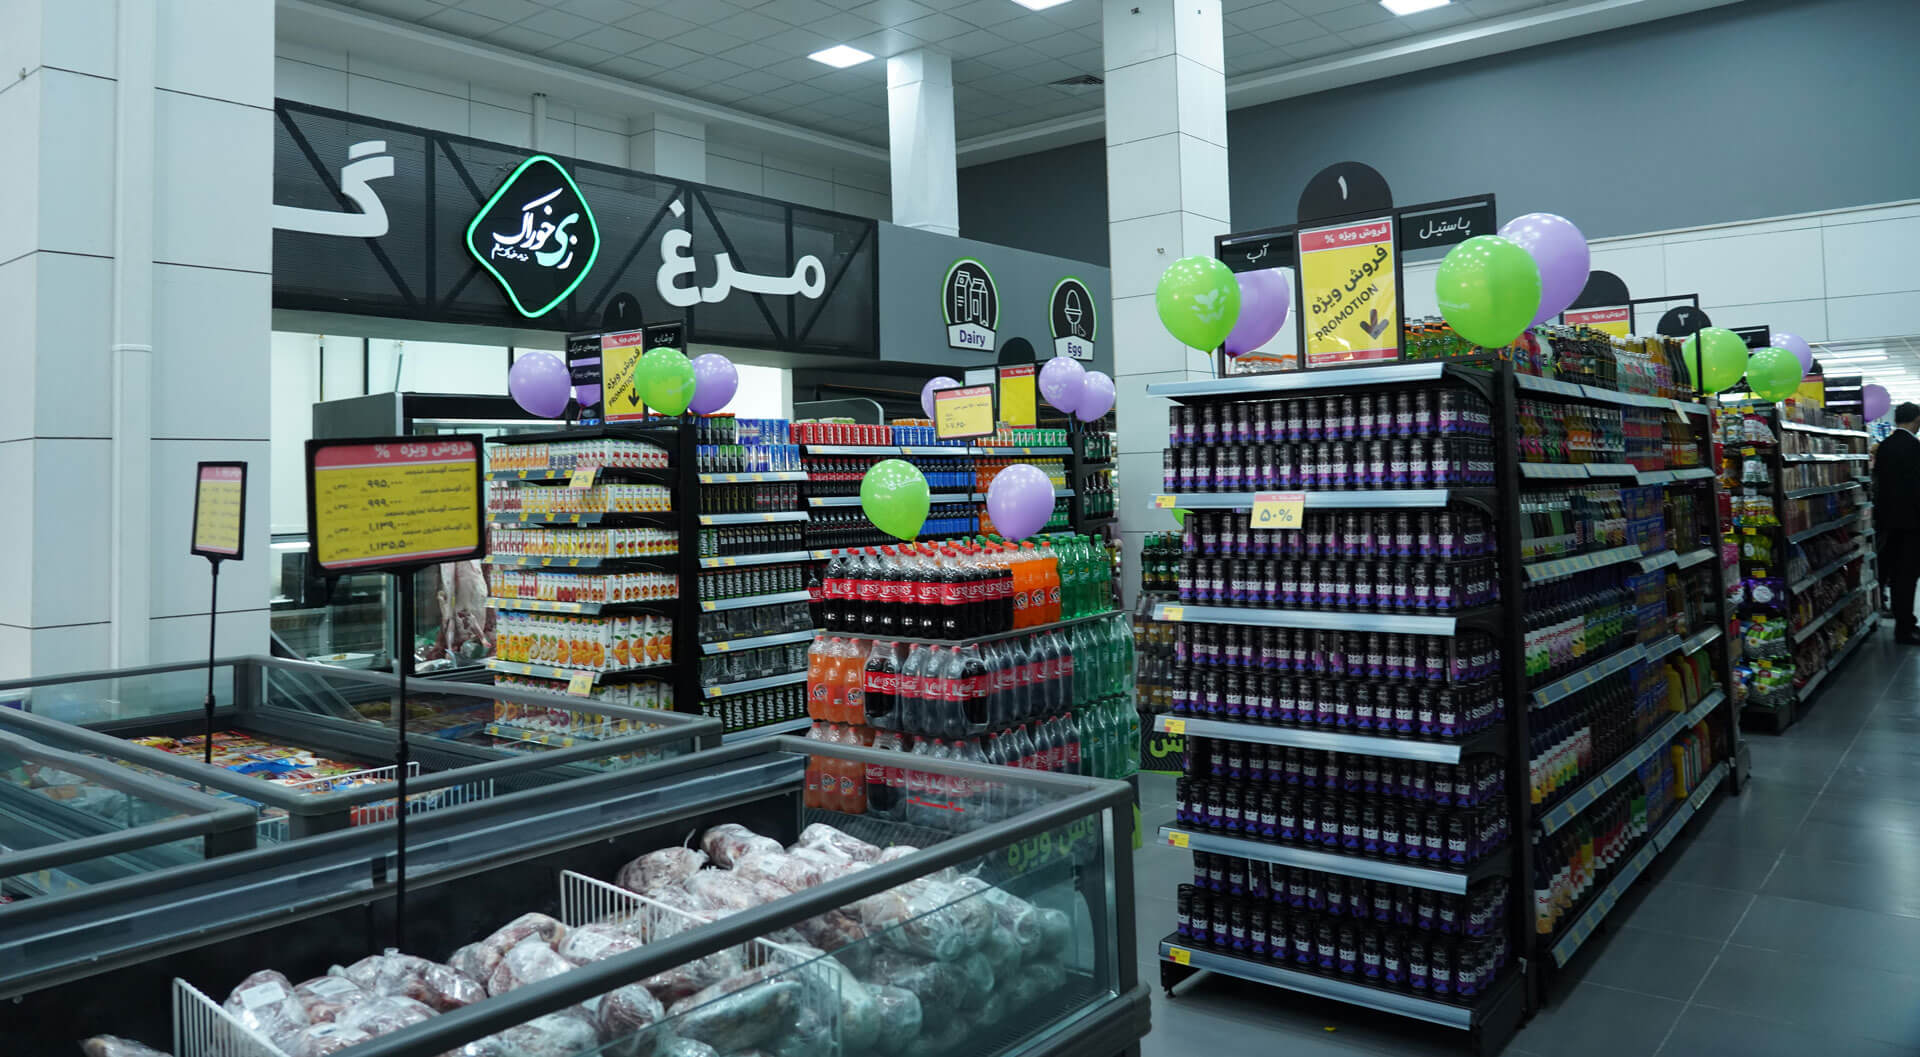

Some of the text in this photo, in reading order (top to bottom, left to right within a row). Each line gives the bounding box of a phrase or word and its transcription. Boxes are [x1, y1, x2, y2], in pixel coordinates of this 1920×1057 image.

[1337, 175, 1347, 200] ۱
[1338, 231, 1357, 241] ویژه
[1359, 223, 1387, 239] فروش
[1420, 216, 1471, 239] پاستیل
[656, 199, 826, 307] مرغ
[1246, 243, 1269, 260] آب
[1312, 244, 1388, 314] فروش ویژه
[1315, 283, 1378, 342] PROMOTION
[960, 329, 986, 347] Dairy
[1067, 342, 1083, 357] Egg
[607, 348, 641, 391] فروش ویژه
[608, 373, 636, 407] PROMOTIO
